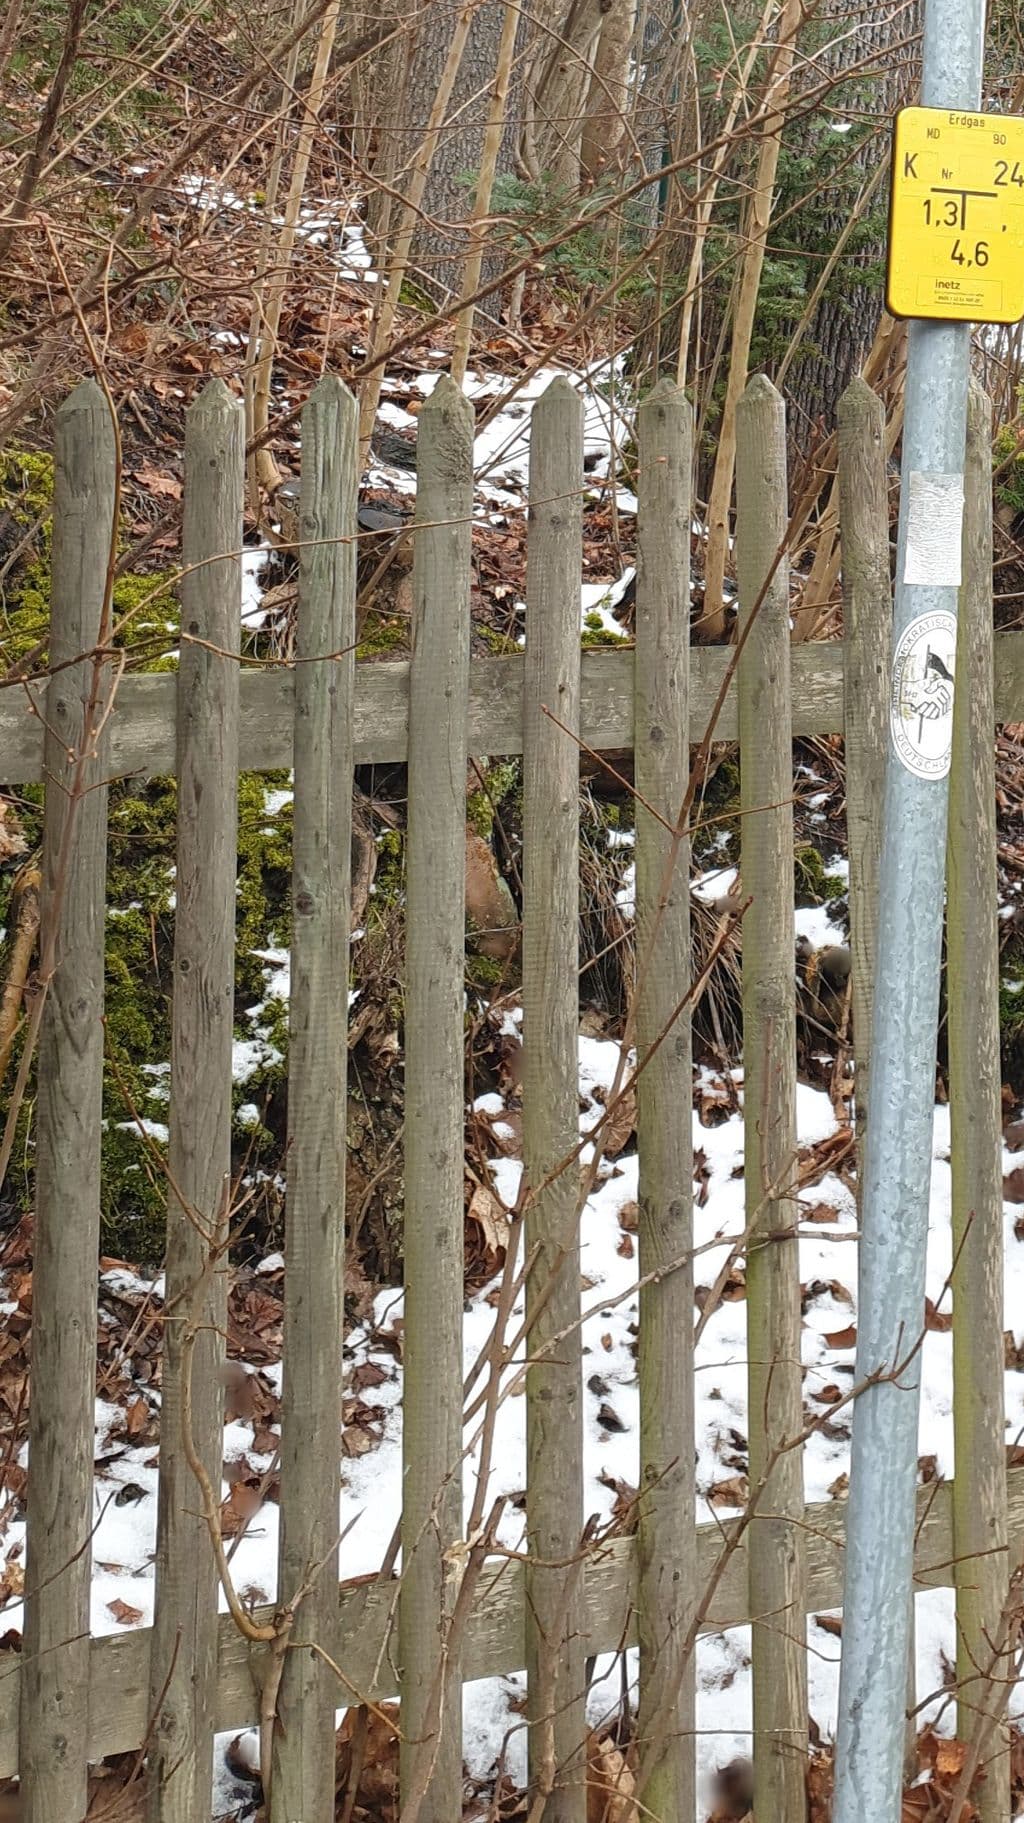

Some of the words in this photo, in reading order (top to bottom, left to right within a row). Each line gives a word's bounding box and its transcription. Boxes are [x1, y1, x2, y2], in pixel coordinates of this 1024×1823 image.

[949, 113, 985, 128] Erdgas
[904, 152, 919, 179] K
[942, 168, 953, 179] Nr
[994, 160, 1024, 188] 24
[923, 199, 958, 227] 1,3
[951, 239, 989, 268] 4,6
